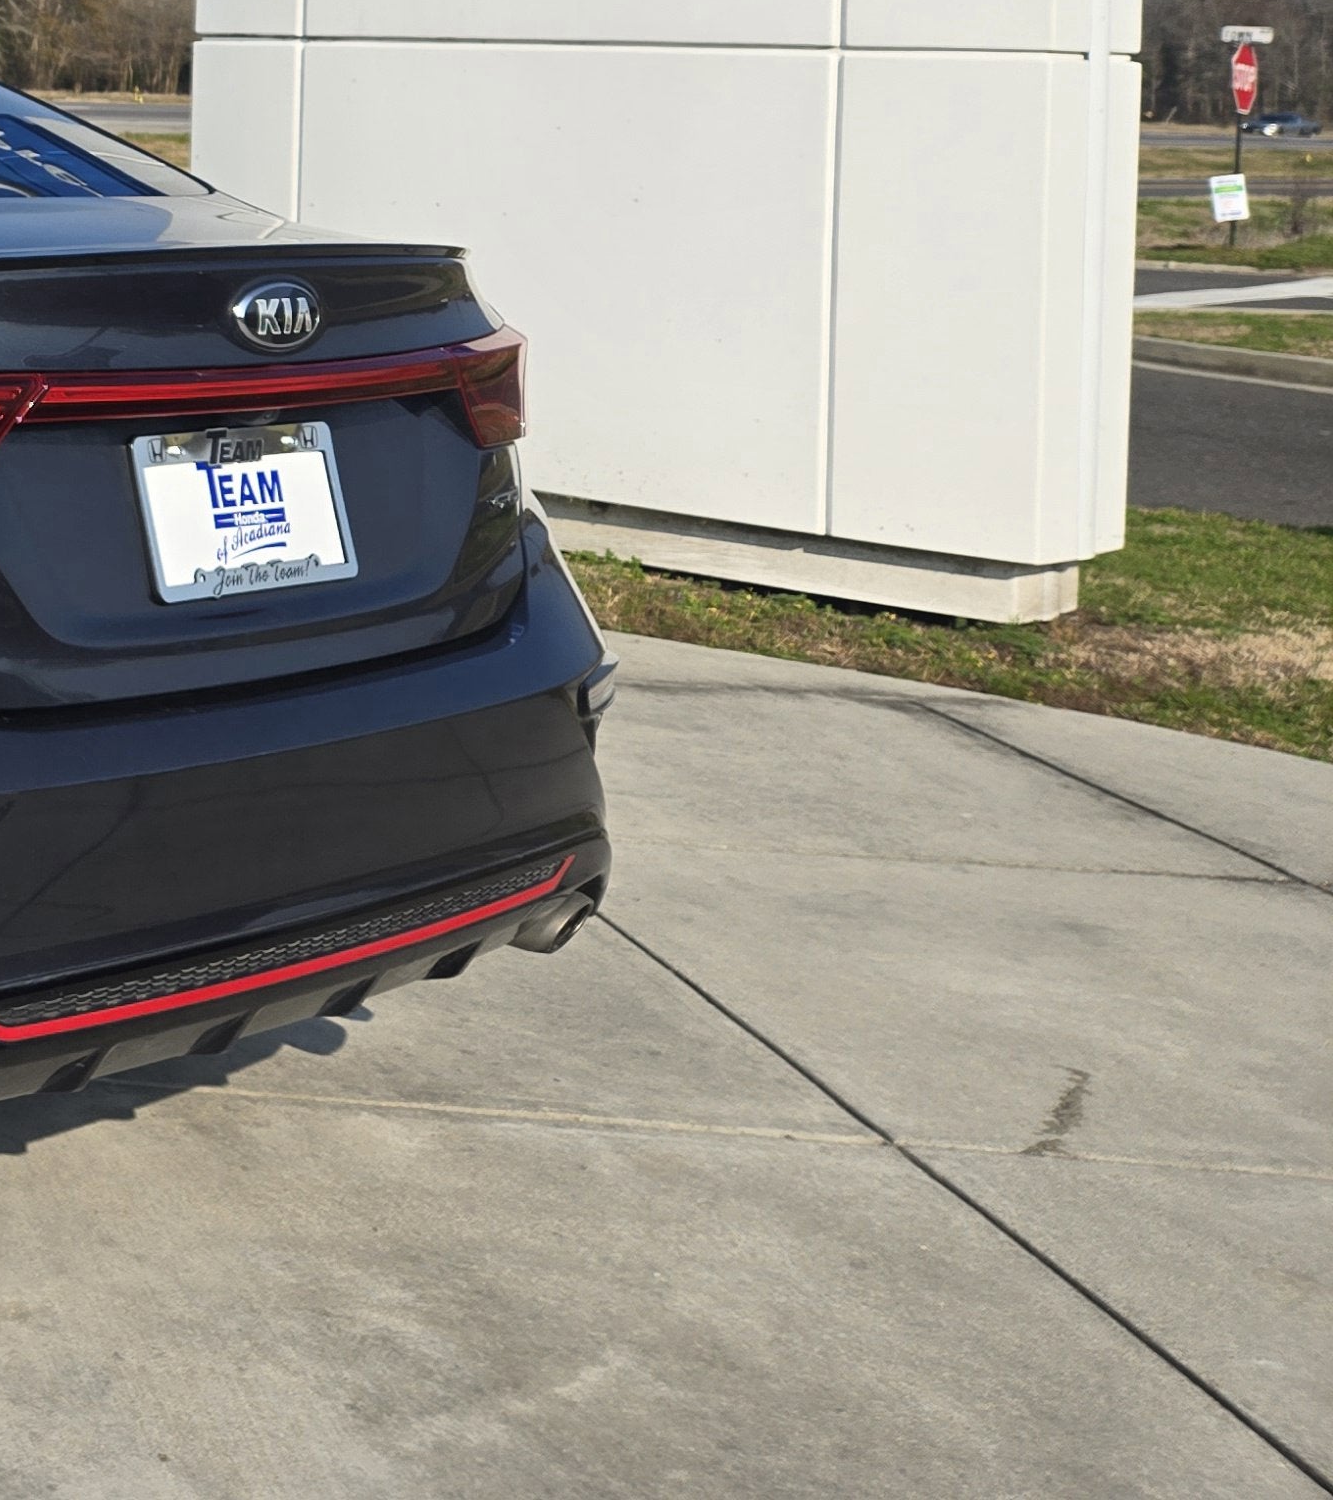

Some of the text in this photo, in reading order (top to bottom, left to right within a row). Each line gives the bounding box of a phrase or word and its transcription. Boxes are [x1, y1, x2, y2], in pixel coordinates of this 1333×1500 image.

[254, 297, 313, 336] KIA
[234, 512, 267, 526] Honda
[217, 522, 291, 565] of Acadiana
[213, 566, 244, 597] Join
[240, 562, 270, 586] The
